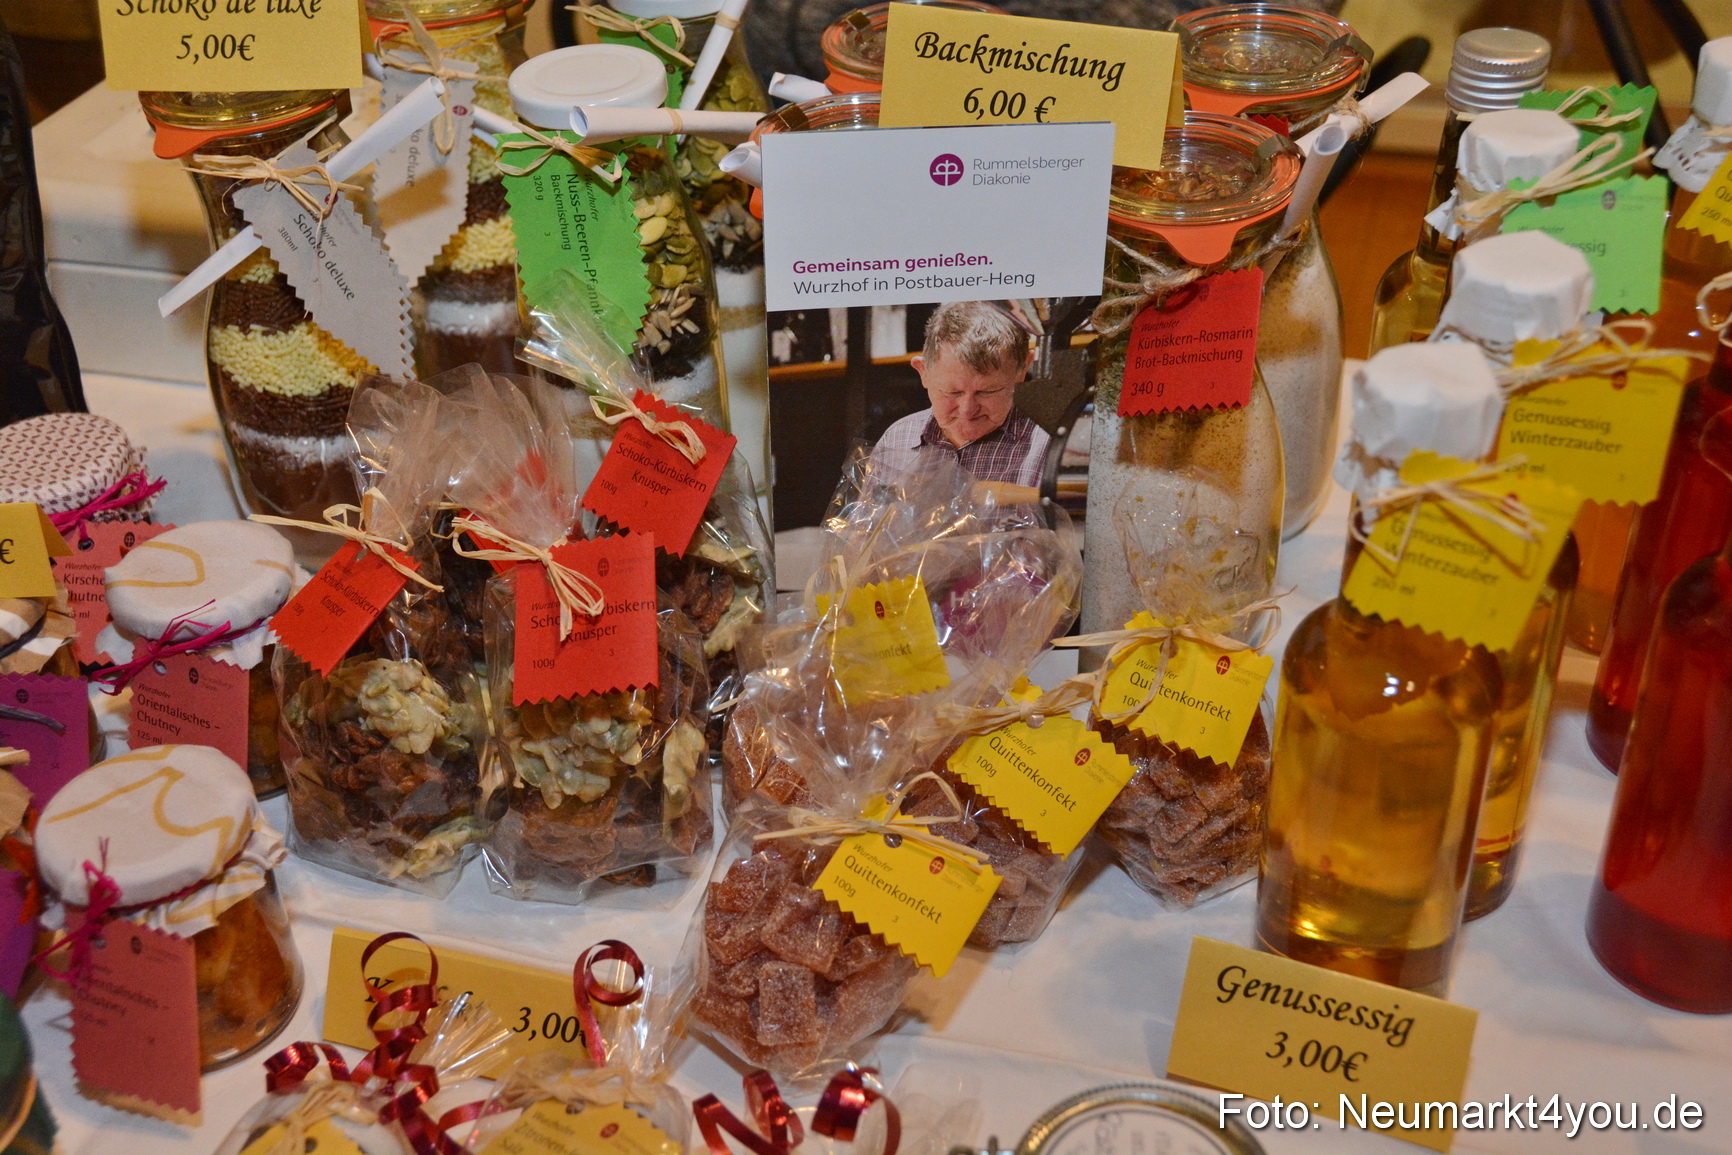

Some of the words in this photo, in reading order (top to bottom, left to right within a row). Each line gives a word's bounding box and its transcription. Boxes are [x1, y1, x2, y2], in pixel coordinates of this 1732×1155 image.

[176, 34, 256, 65] 5,00€
[914, 31, 1126, 92] Backmischung
[963, 87, 1026, 120] 6,00
[1033, 95, 1057, 123] €
[972, 156, 1085, 172] Rummelsberger
[533, 175, 544, 195] 320
[972, 172, 1031, 186] Diakonie
[550, 174, 572, 250] Backmischung
[277, 226, 299, 252] 380ml
[792, 257, 900, 274] Gemeinsam
[905, 252, 993, 272] genießen.
[324, 260, 355, 301] deluxe
[793, 277, 869, 295] Wurzhof
[873, 277, 889, 291] in
[894, 270, 1035, 290] Postbauer-Heng
[1137, 326, 1254, 350] Kürbiskern-Rosmarin
[1134, 348, 1243, 369] Brot-Backmischung
[1131, 380, 1154, 396] 340
[1156, 382, 1165, 397] g
[1512, 407, 1612, 435] Genussessig
[1509, 429, 1623, 454] Winterzauber
[615, 441, 707, 493] Schoko-Kürbiskern
[600, 478, 618, 496] 100g
[631, 469, 672, 496] Knusper
[532, 658, 556, 669] 100g
[1135, 658, 1178, 680] Wurzfer
[1129, 671, 1232, 722] Quitenkonfekt
[136, 709, 181, 737] Chutney
[137, 693, 212, 729] Orientalisches
[137, 729, 151, 741] 125
[1199, 726, 1206, 735] 3
[976, 755, 997, 778] 100g
[989, 735, 1078, 813] Quittenkonfekt
[852, 842, 895, 873] Wurzhofer
[833, 875, 857, 898] 100g
[844, 855, 943, 925] Quittenkonfekt
[1215, 964, 1416, 1048] Genussessig
[1264, 1030, 1368, 1083] 3,00€
